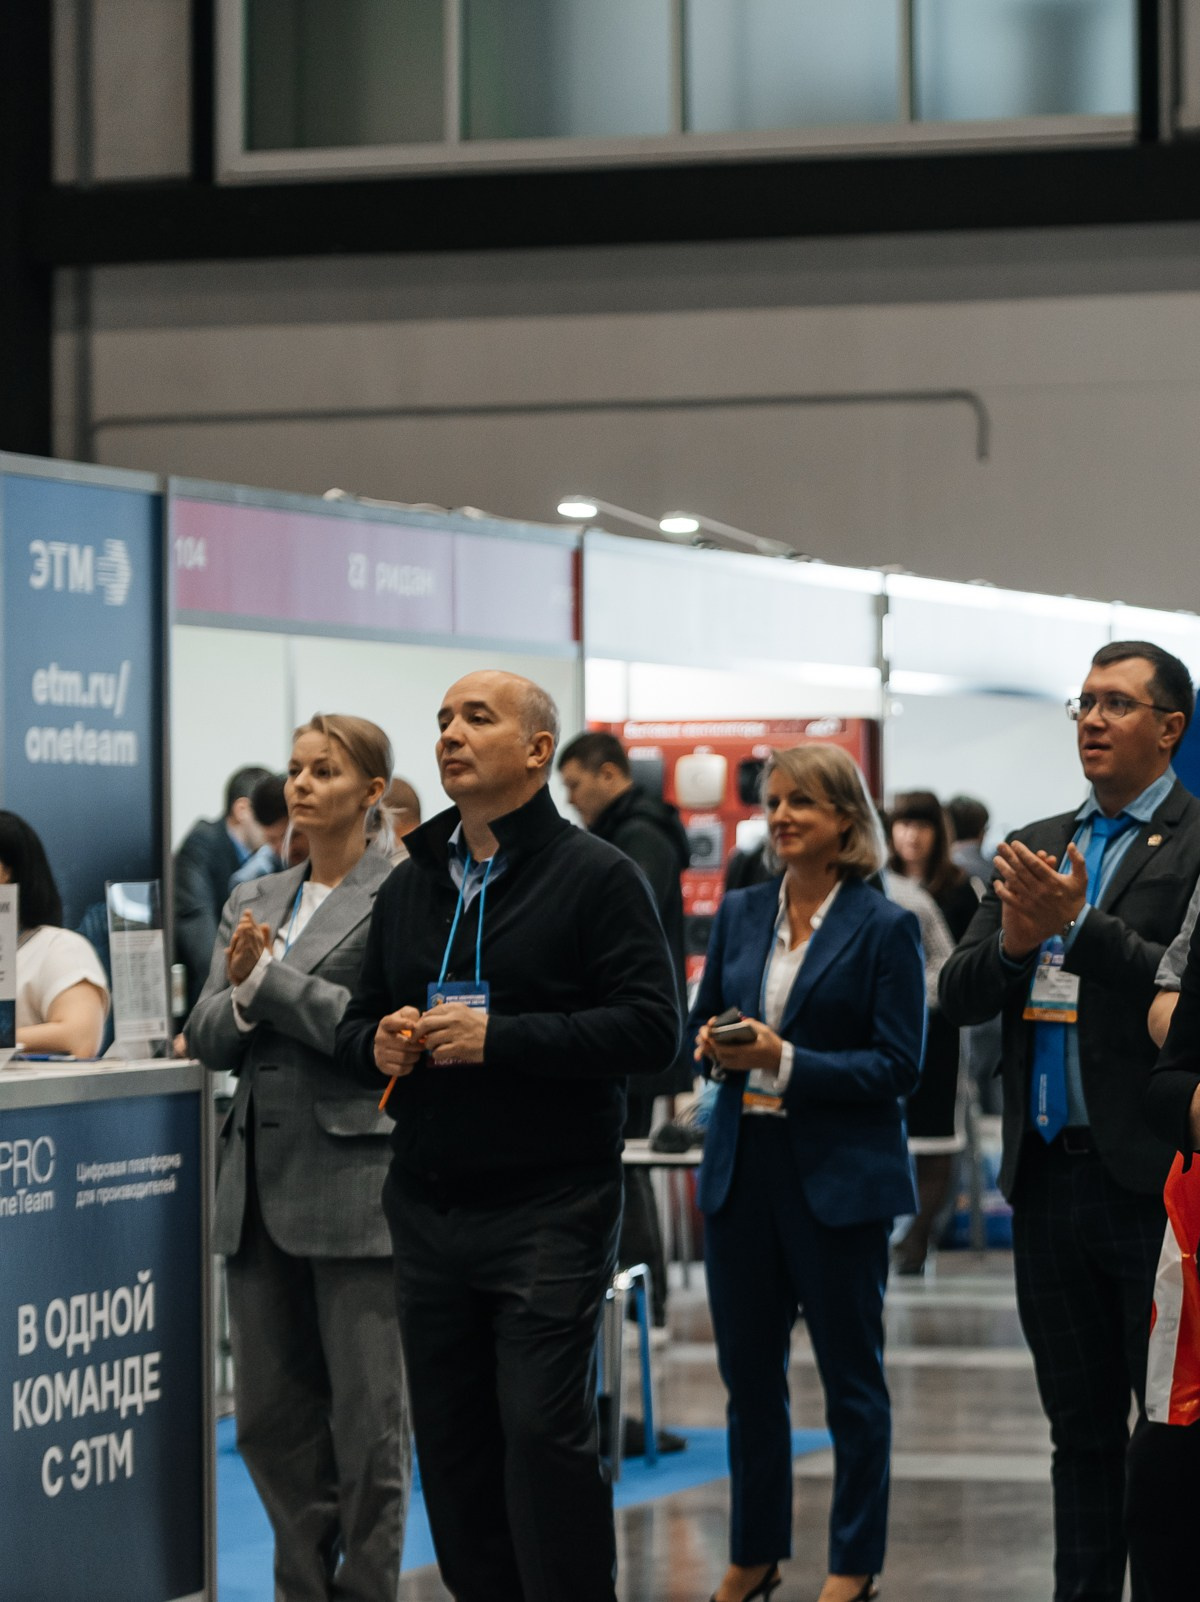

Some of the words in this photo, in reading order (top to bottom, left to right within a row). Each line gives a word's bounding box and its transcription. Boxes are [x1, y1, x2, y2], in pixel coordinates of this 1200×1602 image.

[29, 539, 94, 593] ЭТМ
[32, 660, 131, 718] etm.ru/
[25, 721, 138, 767] oneteam
[0, 1188, 54, 1217] neTeam
[18, 1303, 38, 1357] В
[45, 1268, 155, 1358] ОДНОЙ
[13, 1351, 161, 1432] КОМАНДЕ
[41, 1445, 64, 1498] С
[70, 1428, 134, 1491] ЭТМ
